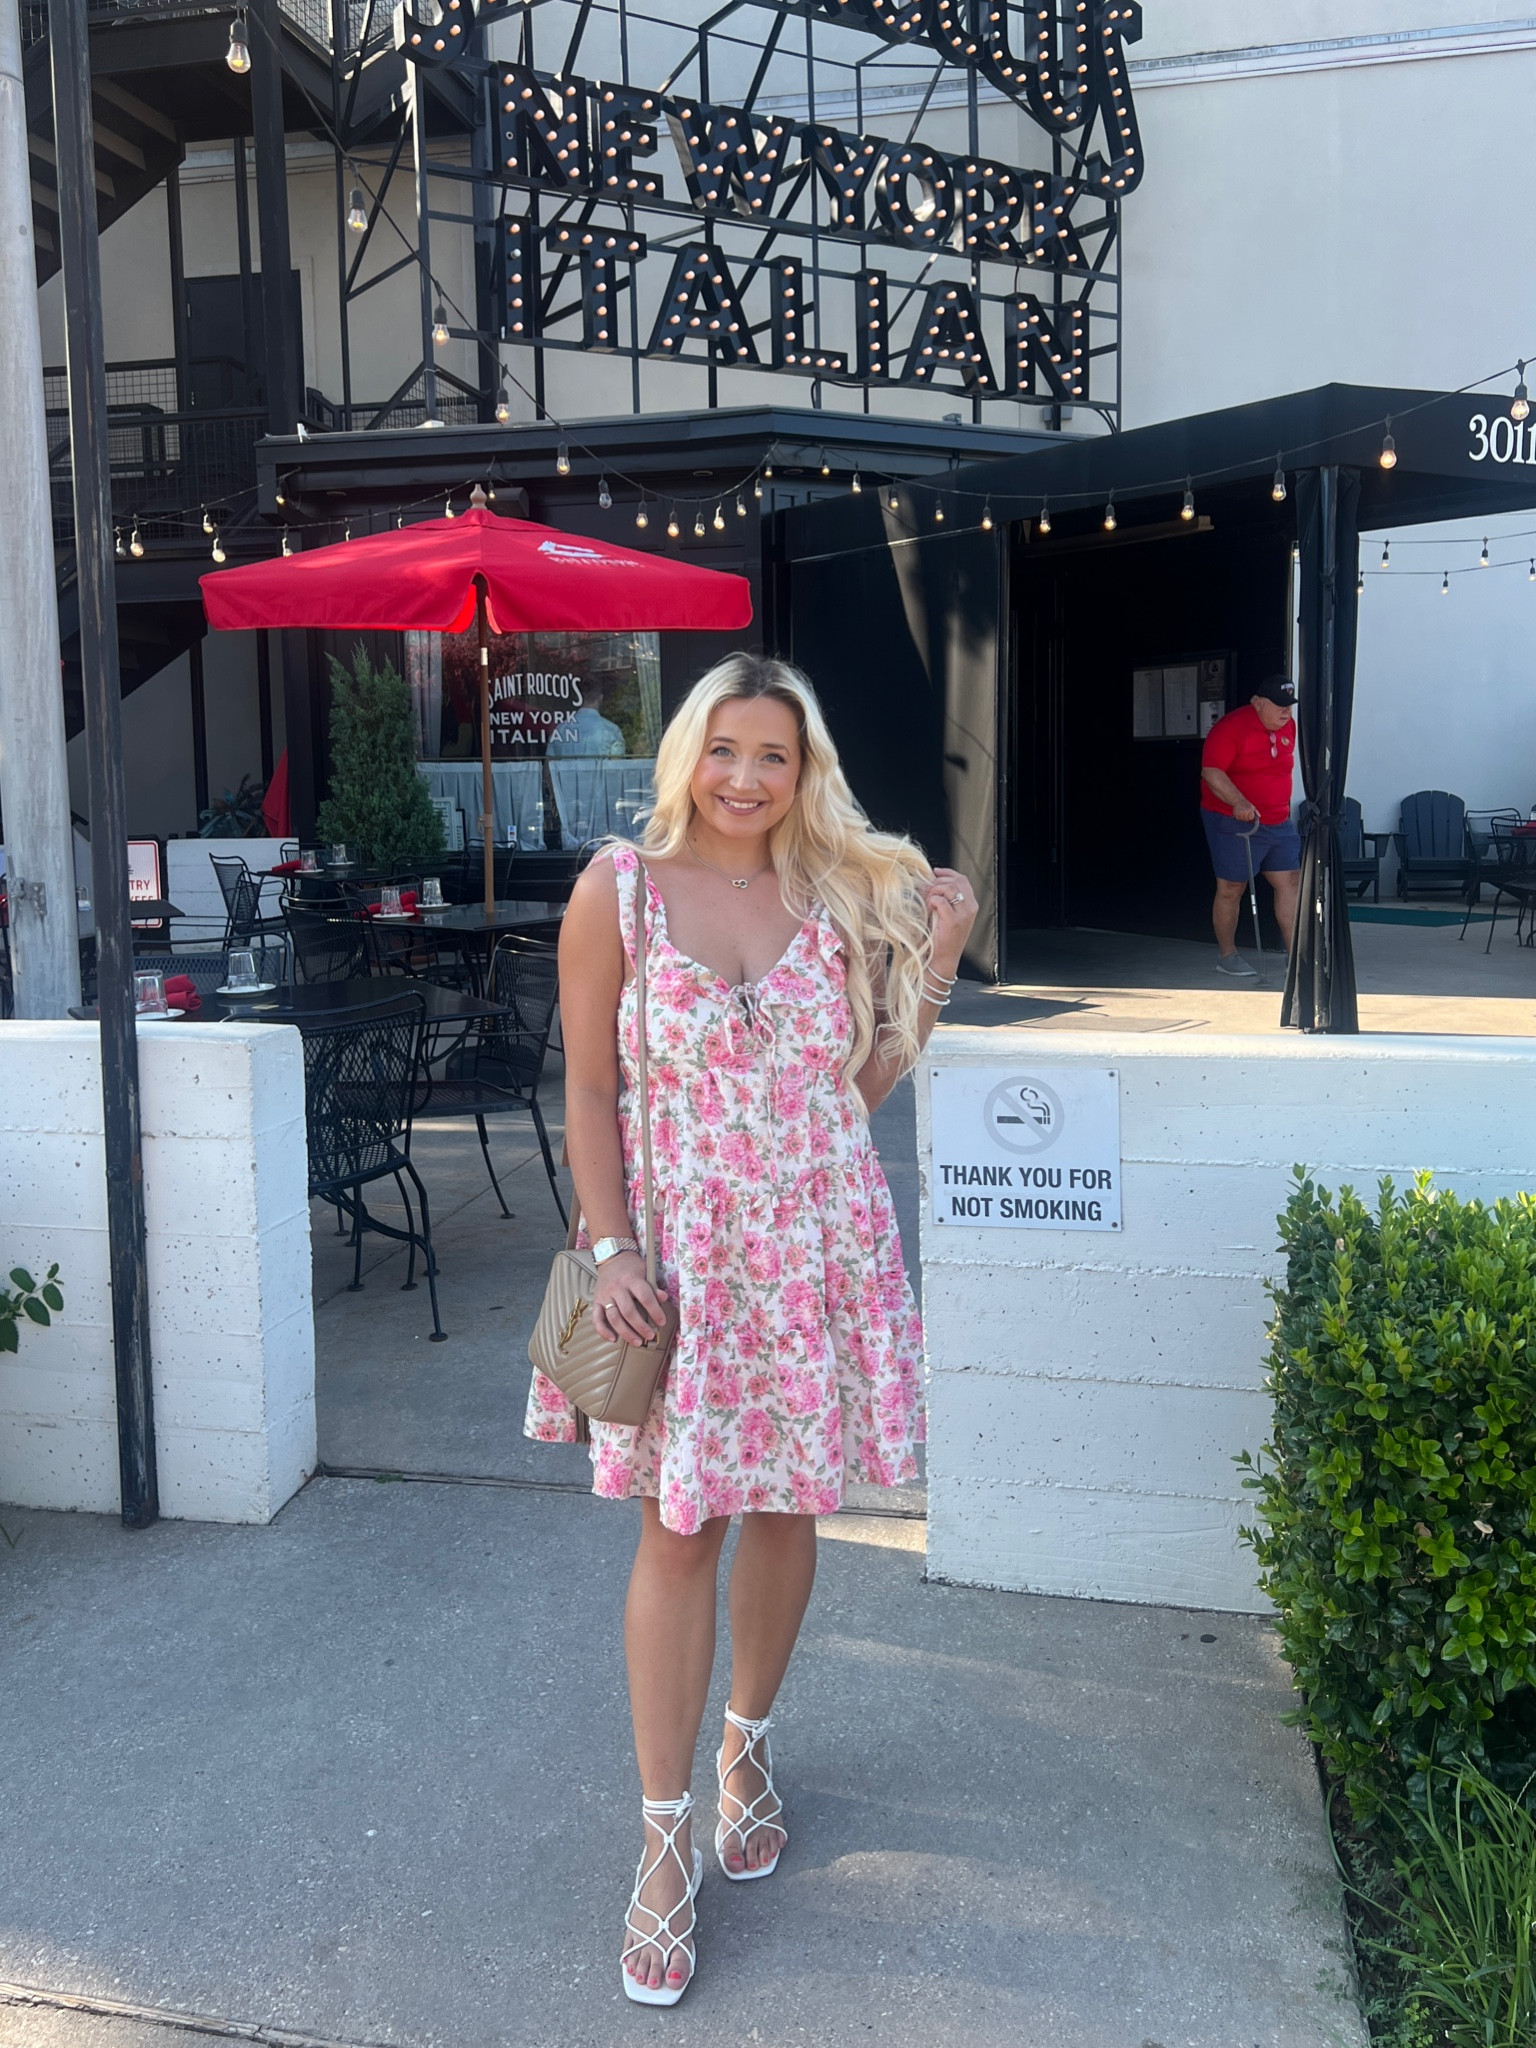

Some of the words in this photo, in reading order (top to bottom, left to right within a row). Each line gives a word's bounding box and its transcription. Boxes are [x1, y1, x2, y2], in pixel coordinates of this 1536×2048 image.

[494, 61, 795, 219] NEW
[802, 124, 1094, 273] YORK
[496, 214, 1091, 402] ITALIAN
[527, 673, 583, 707] ROCCO'S
[490, 712, 524, 725] NEW
[529, 711, 577, 724] YORK
[490, 728, 579, 744] ITALIAN
[129, 879, 150, 891] TRY
[940, 1164, 1013, 1187] THANK
[1019, 1167, 1062, 1188] YOU
[1069, 1168, 1112, 1190] FOR
[951, 1196, 993, 1217] NOT
[999, 1198, 1102, 1222] SMOKING
